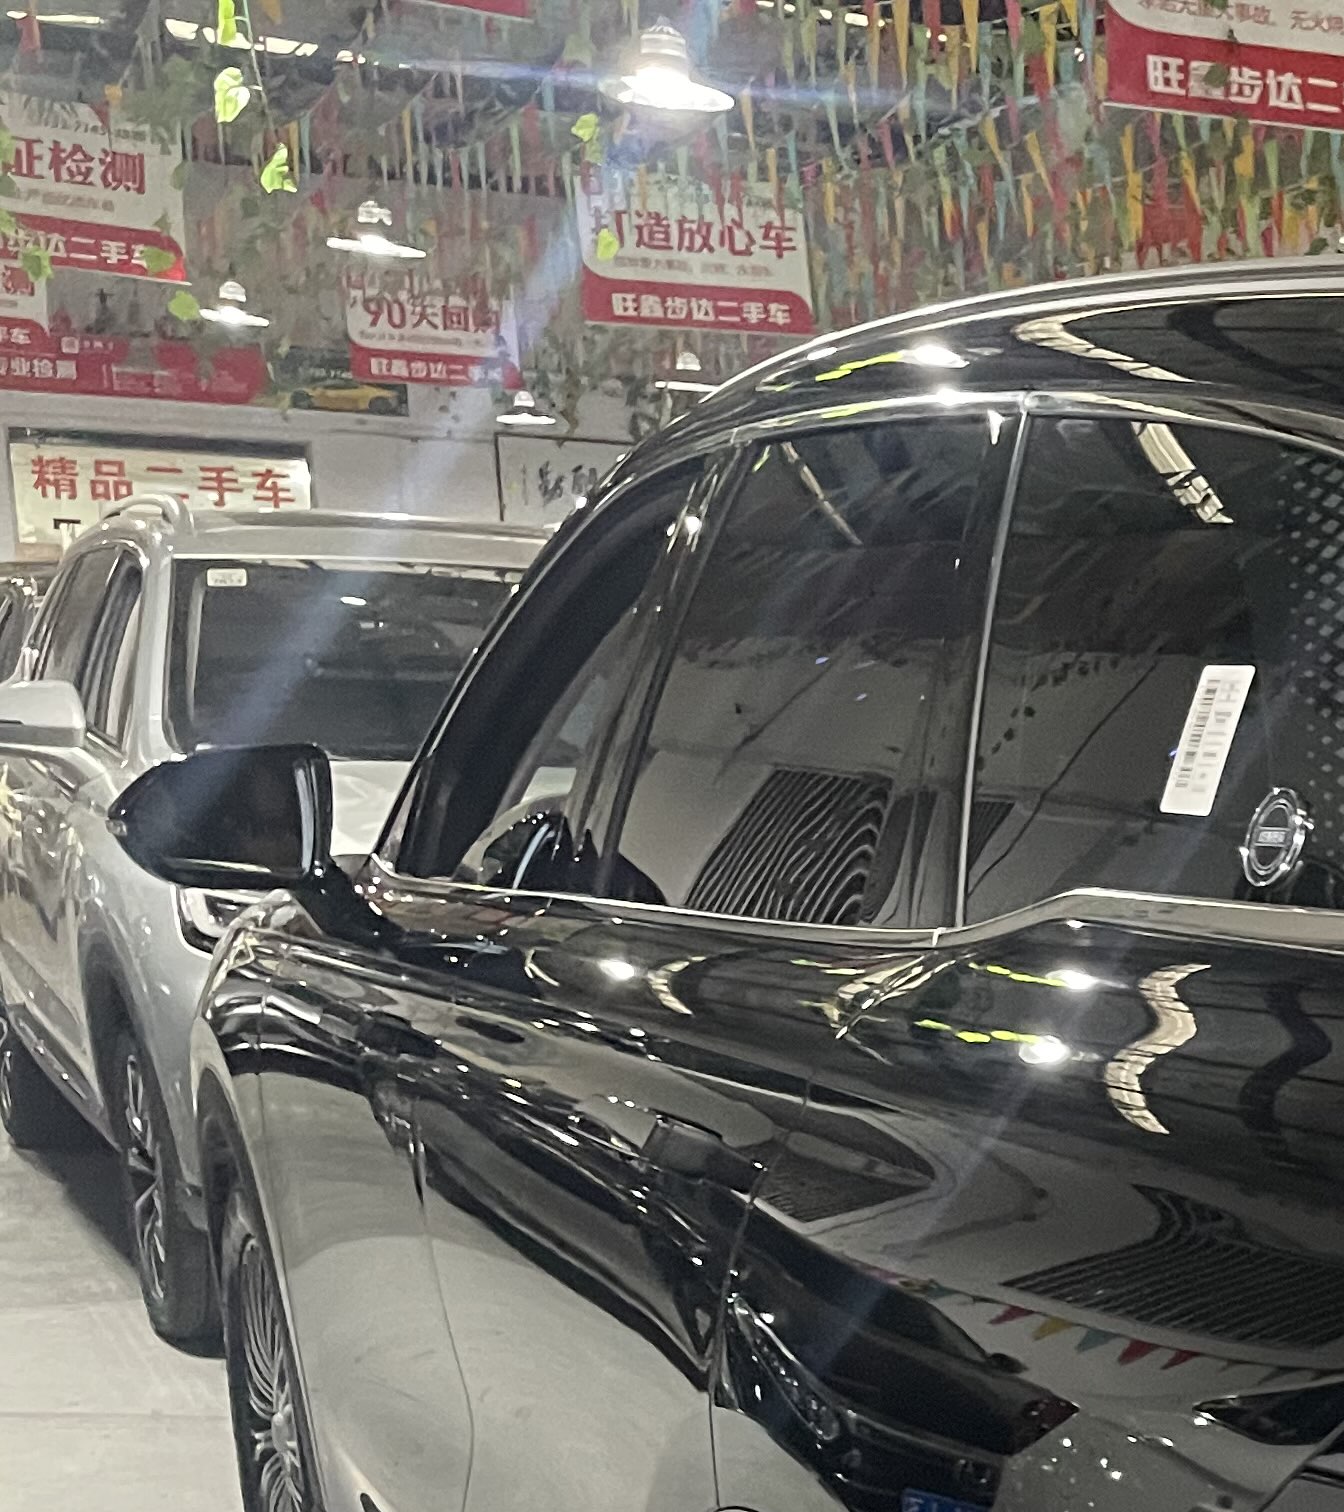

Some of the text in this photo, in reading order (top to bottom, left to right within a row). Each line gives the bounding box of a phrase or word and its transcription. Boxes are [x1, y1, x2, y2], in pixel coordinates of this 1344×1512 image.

[31, 454, 296, 509] 精品二手车
